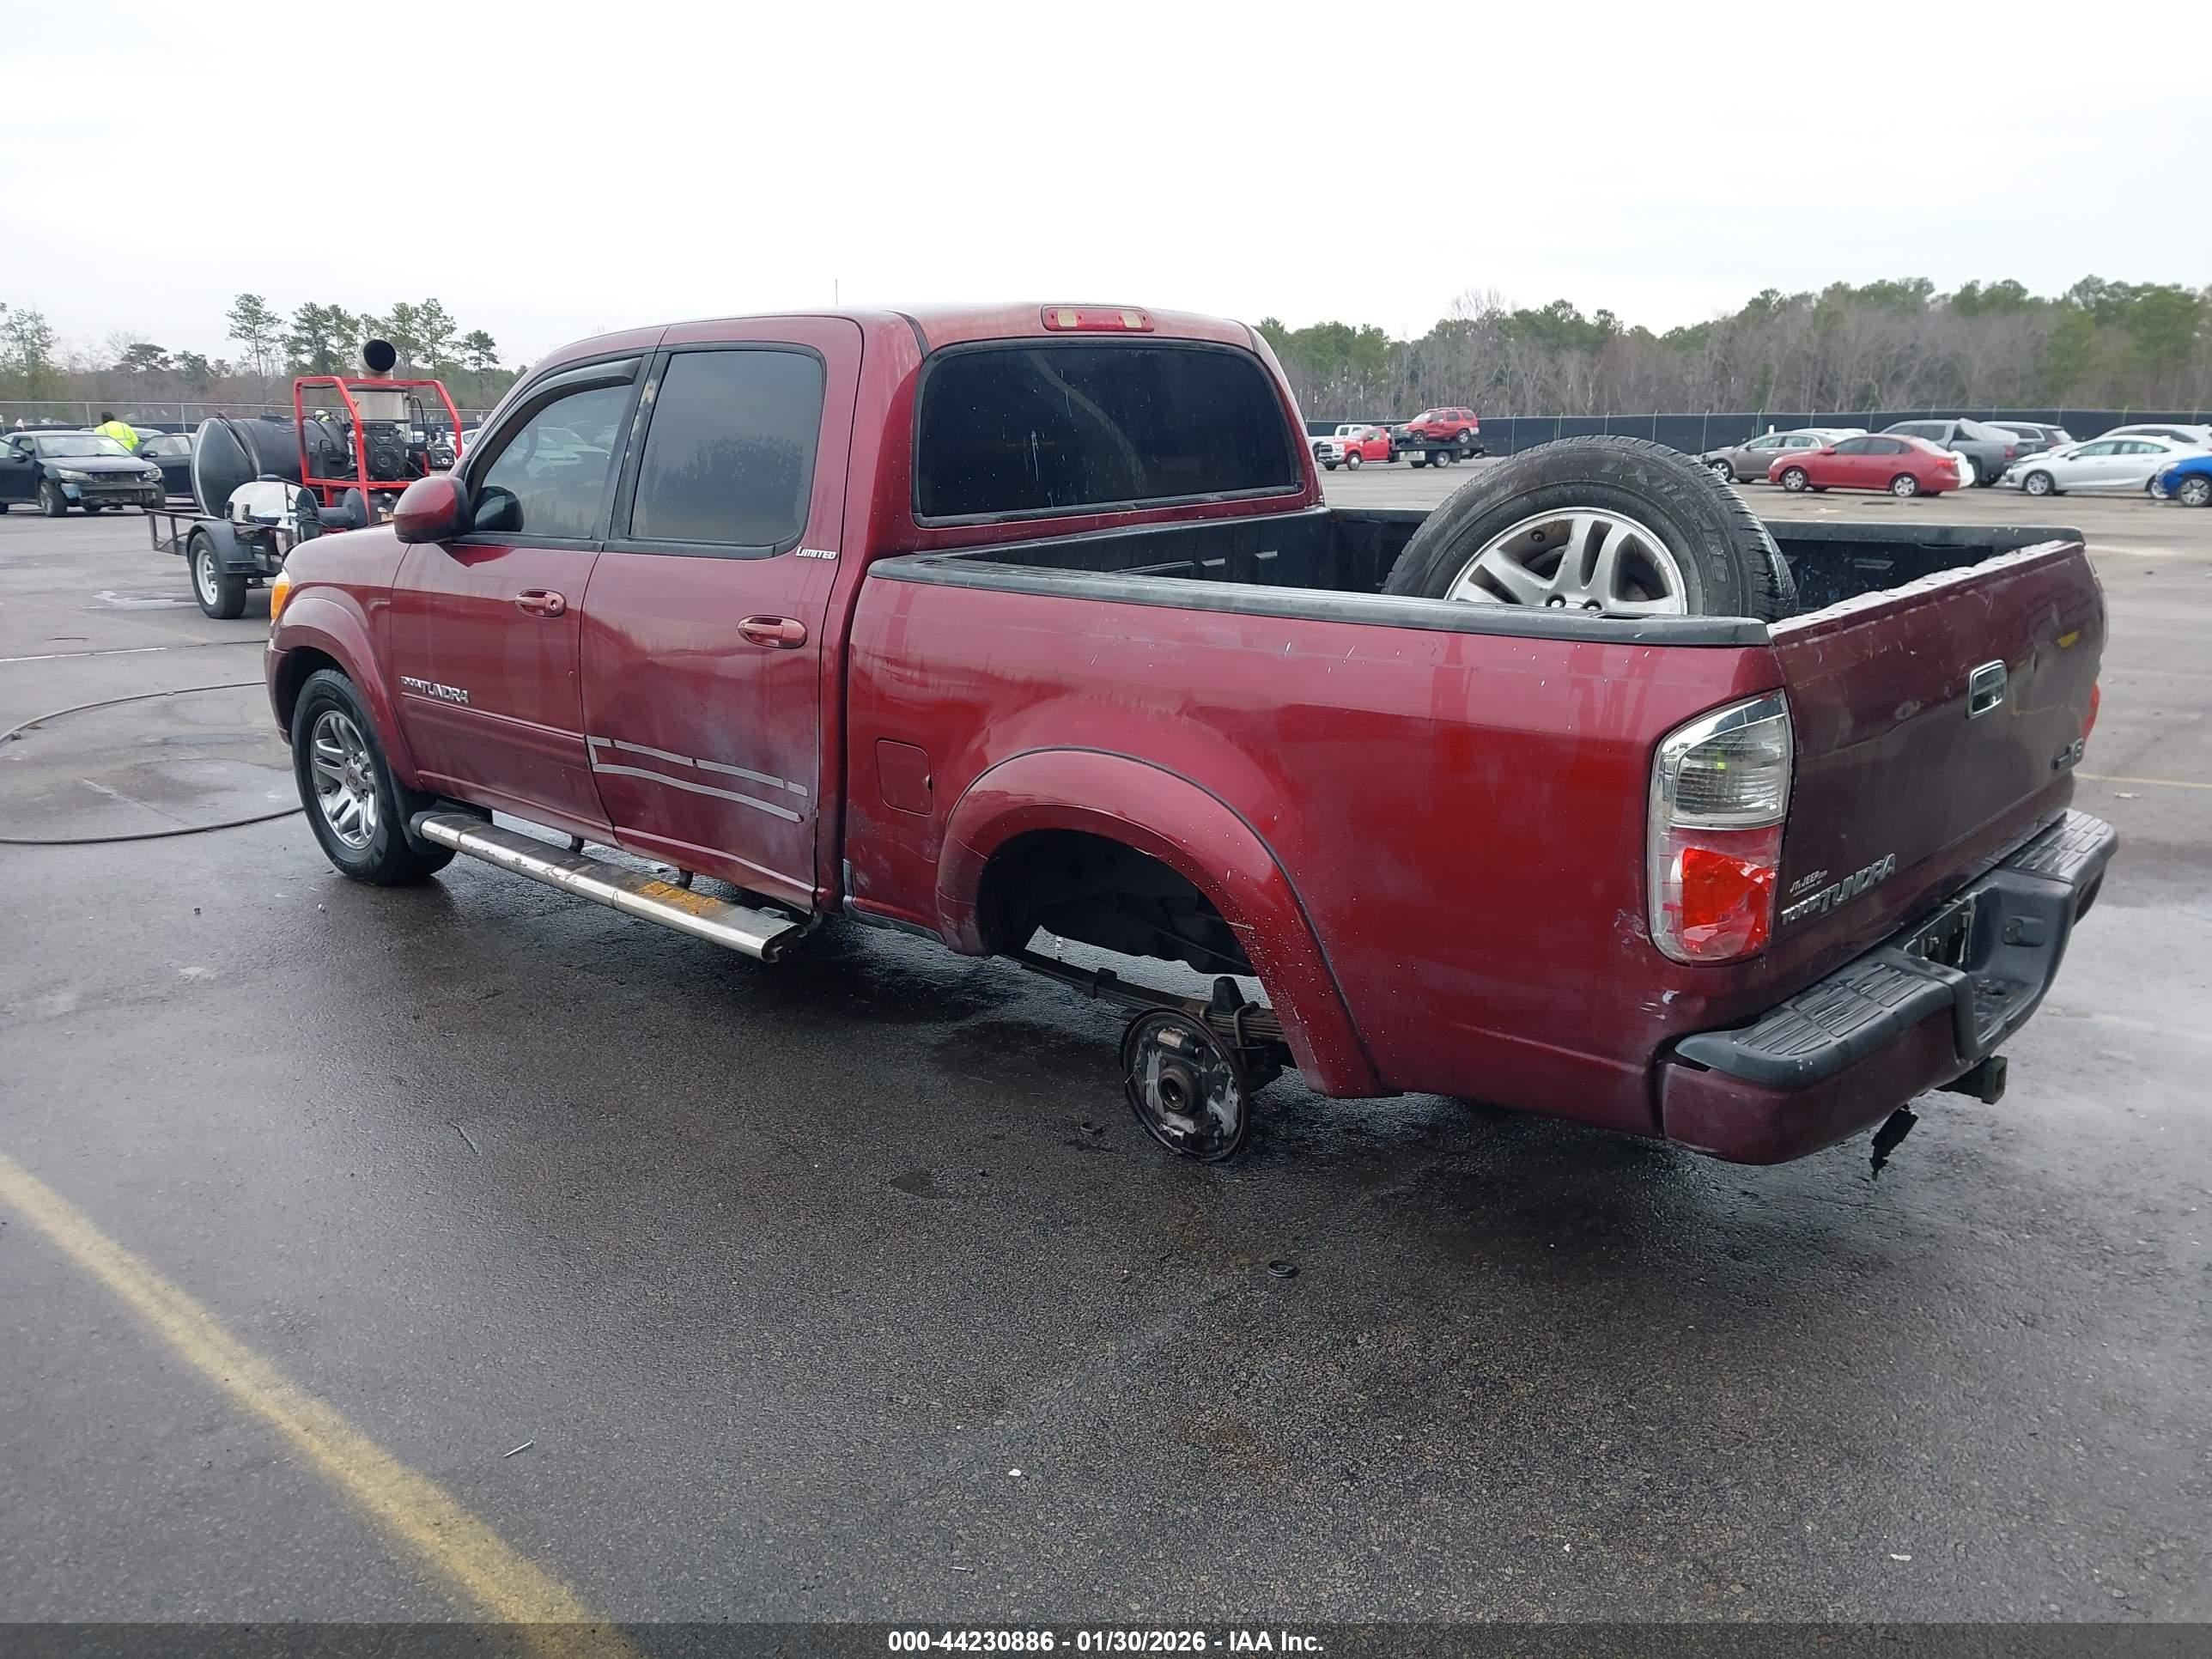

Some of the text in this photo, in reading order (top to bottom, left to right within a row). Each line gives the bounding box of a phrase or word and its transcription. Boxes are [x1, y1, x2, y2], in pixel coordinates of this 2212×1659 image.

[795, 545, 837, 560] LIMITED
[420, 679, 470, 704] TUNDRA
[1819, 852, 1896, 914] TUNDRA
